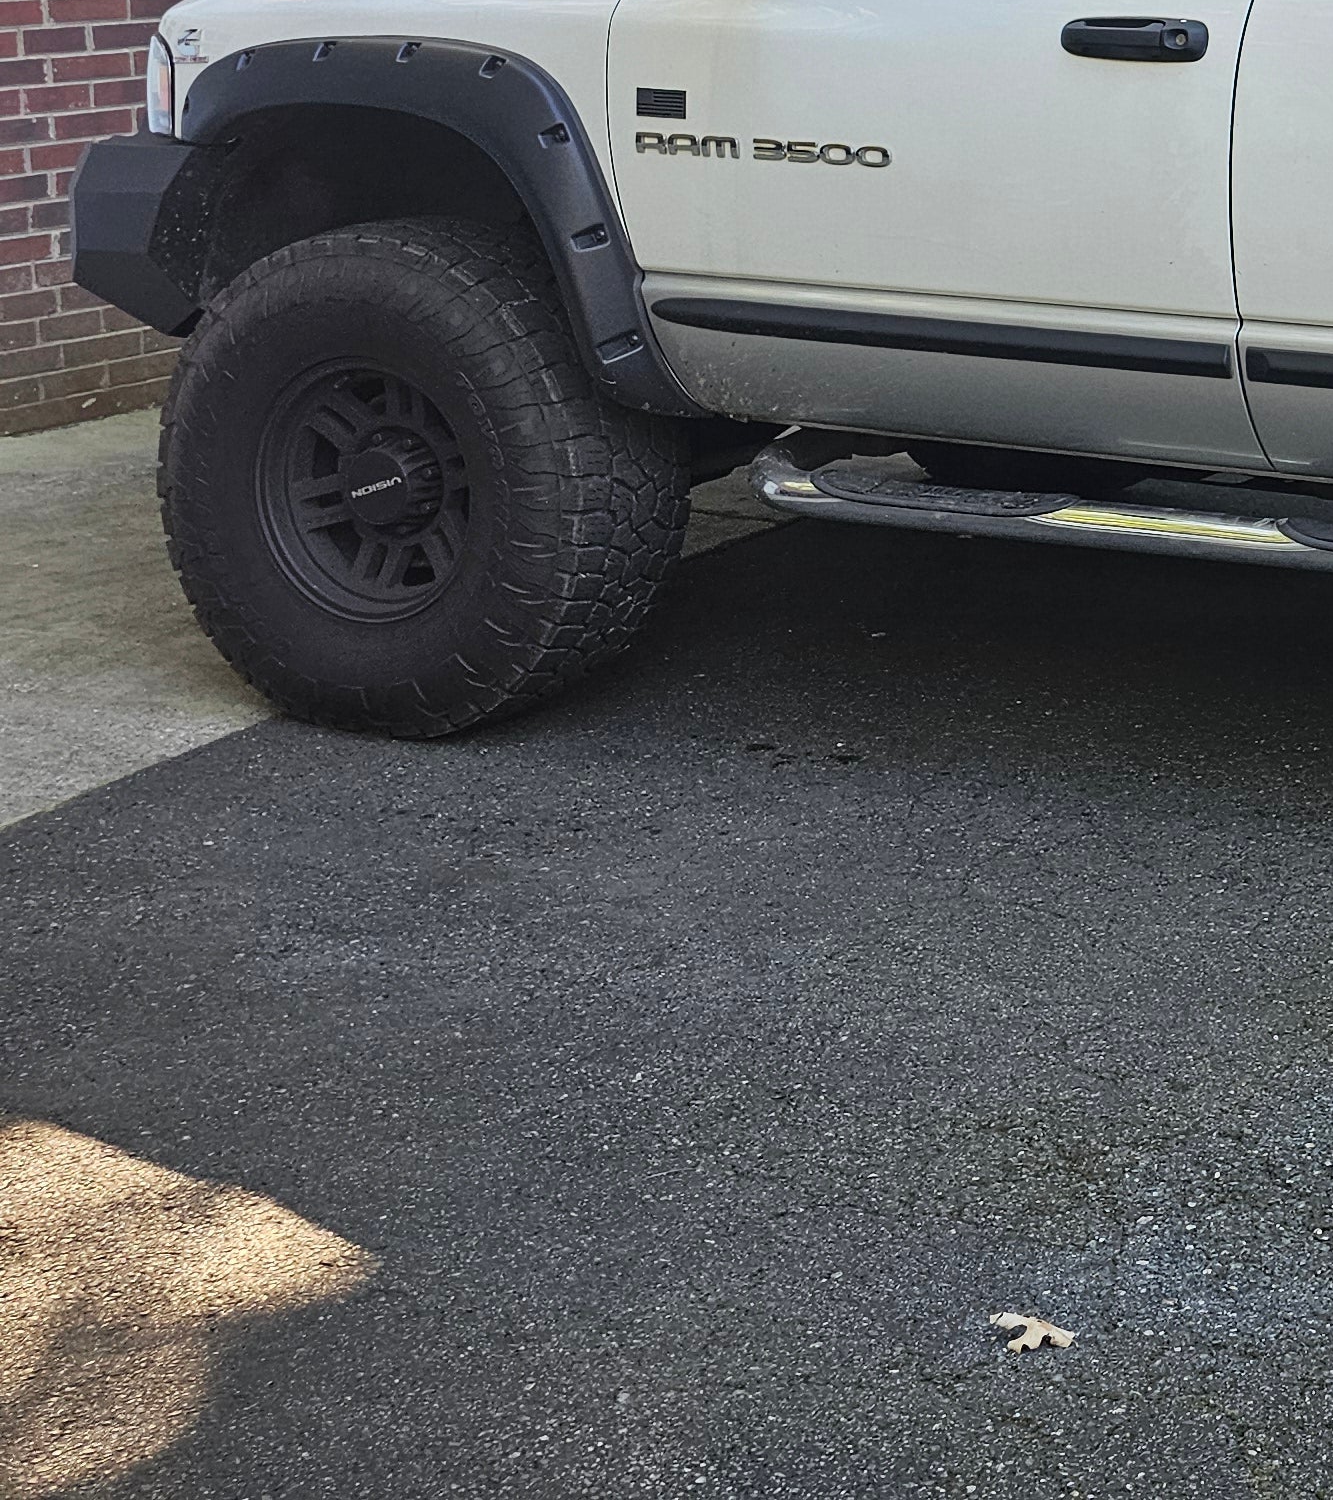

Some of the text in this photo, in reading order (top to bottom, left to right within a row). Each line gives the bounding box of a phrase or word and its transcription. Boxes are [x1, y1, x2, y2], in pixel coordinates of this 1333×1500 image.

[635, 131, 892, 167] RAM 3500
[351, 476, 403, 499] VISION
